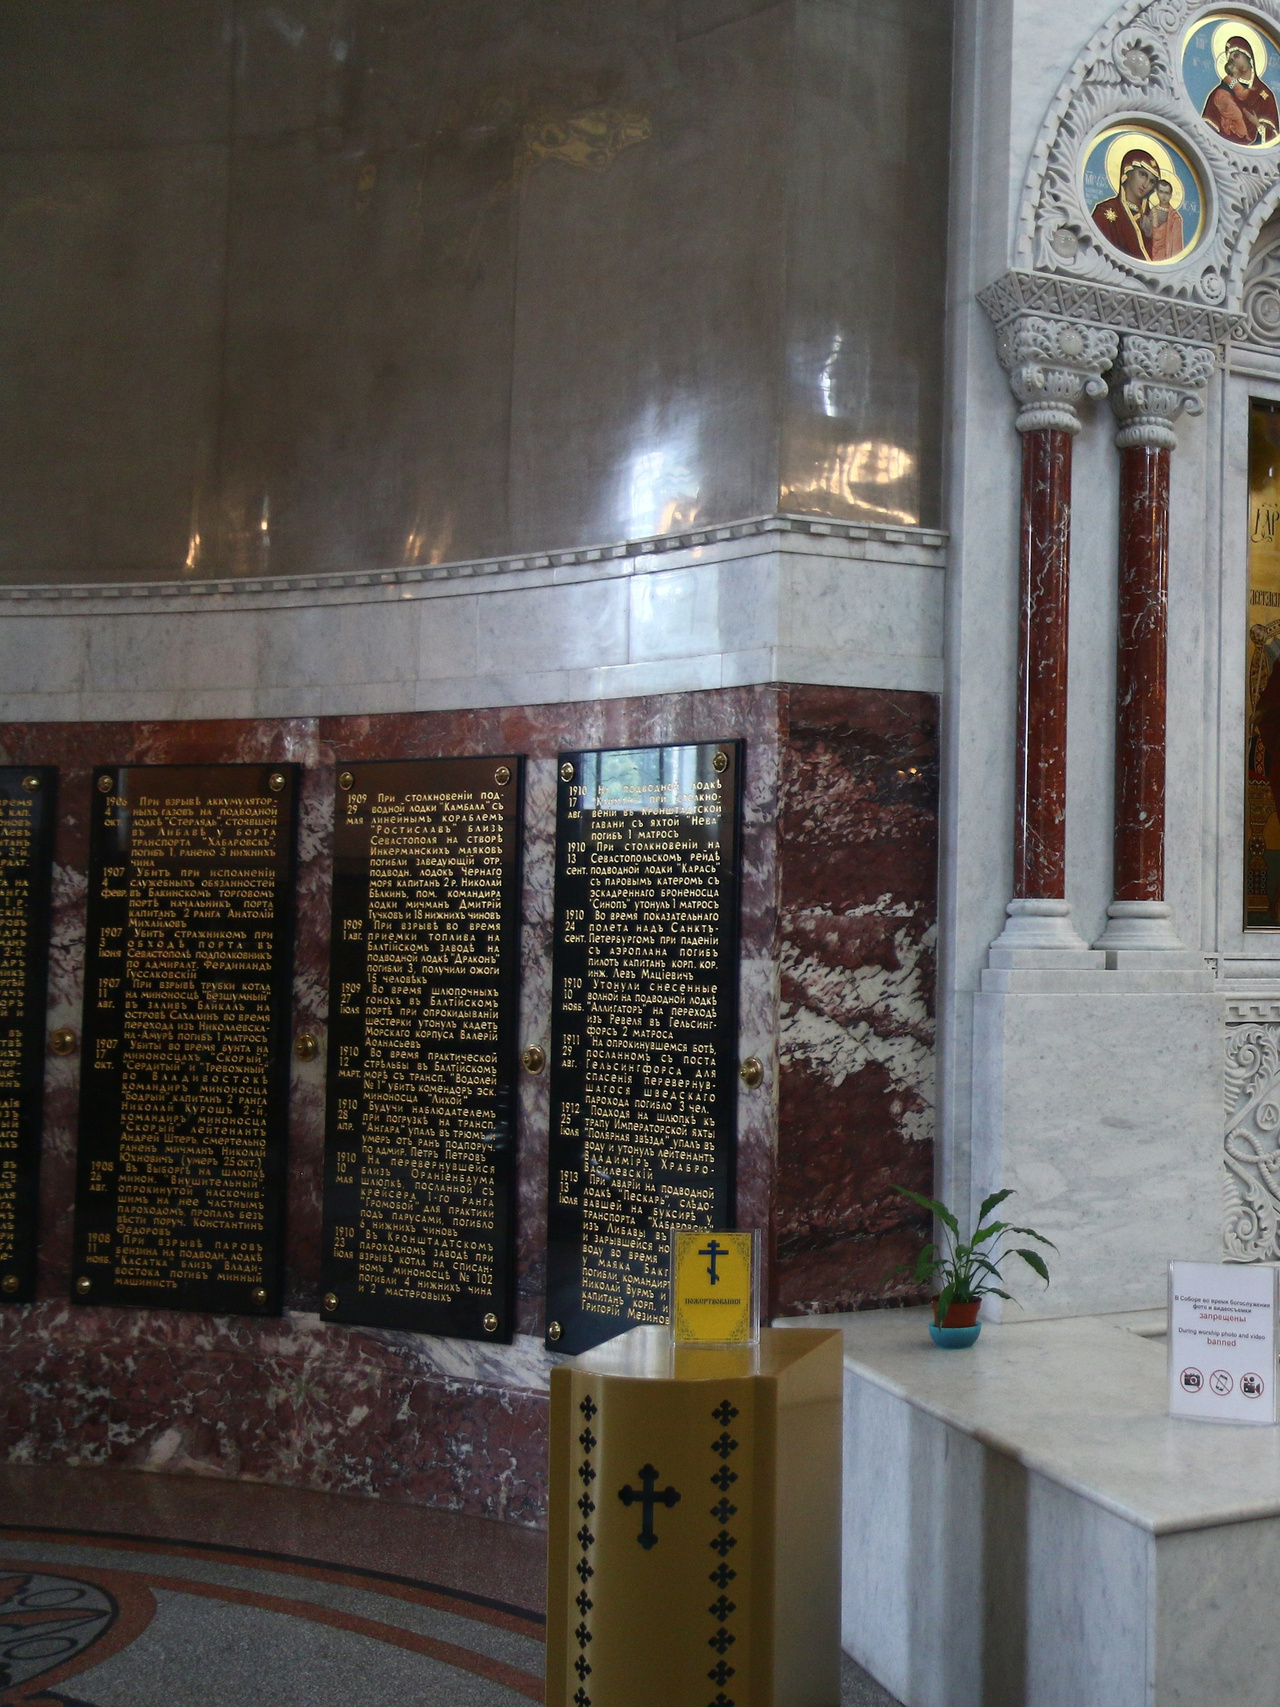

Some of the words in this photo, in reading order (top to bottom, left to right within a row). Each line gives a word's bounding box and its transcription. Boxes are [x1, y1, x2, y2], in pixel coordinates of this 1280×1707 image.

[1180, 1295, 1201, 1303] Соборе
[1199, 1313, 1246, 1322] запрещены
[1178, 1327, 1197, 1335] During
[1198, 1329, 1220, 1337] worship
[1221, 1330, 1237, 1338] photo
[1207, 1337, 1237, 1347] banned
